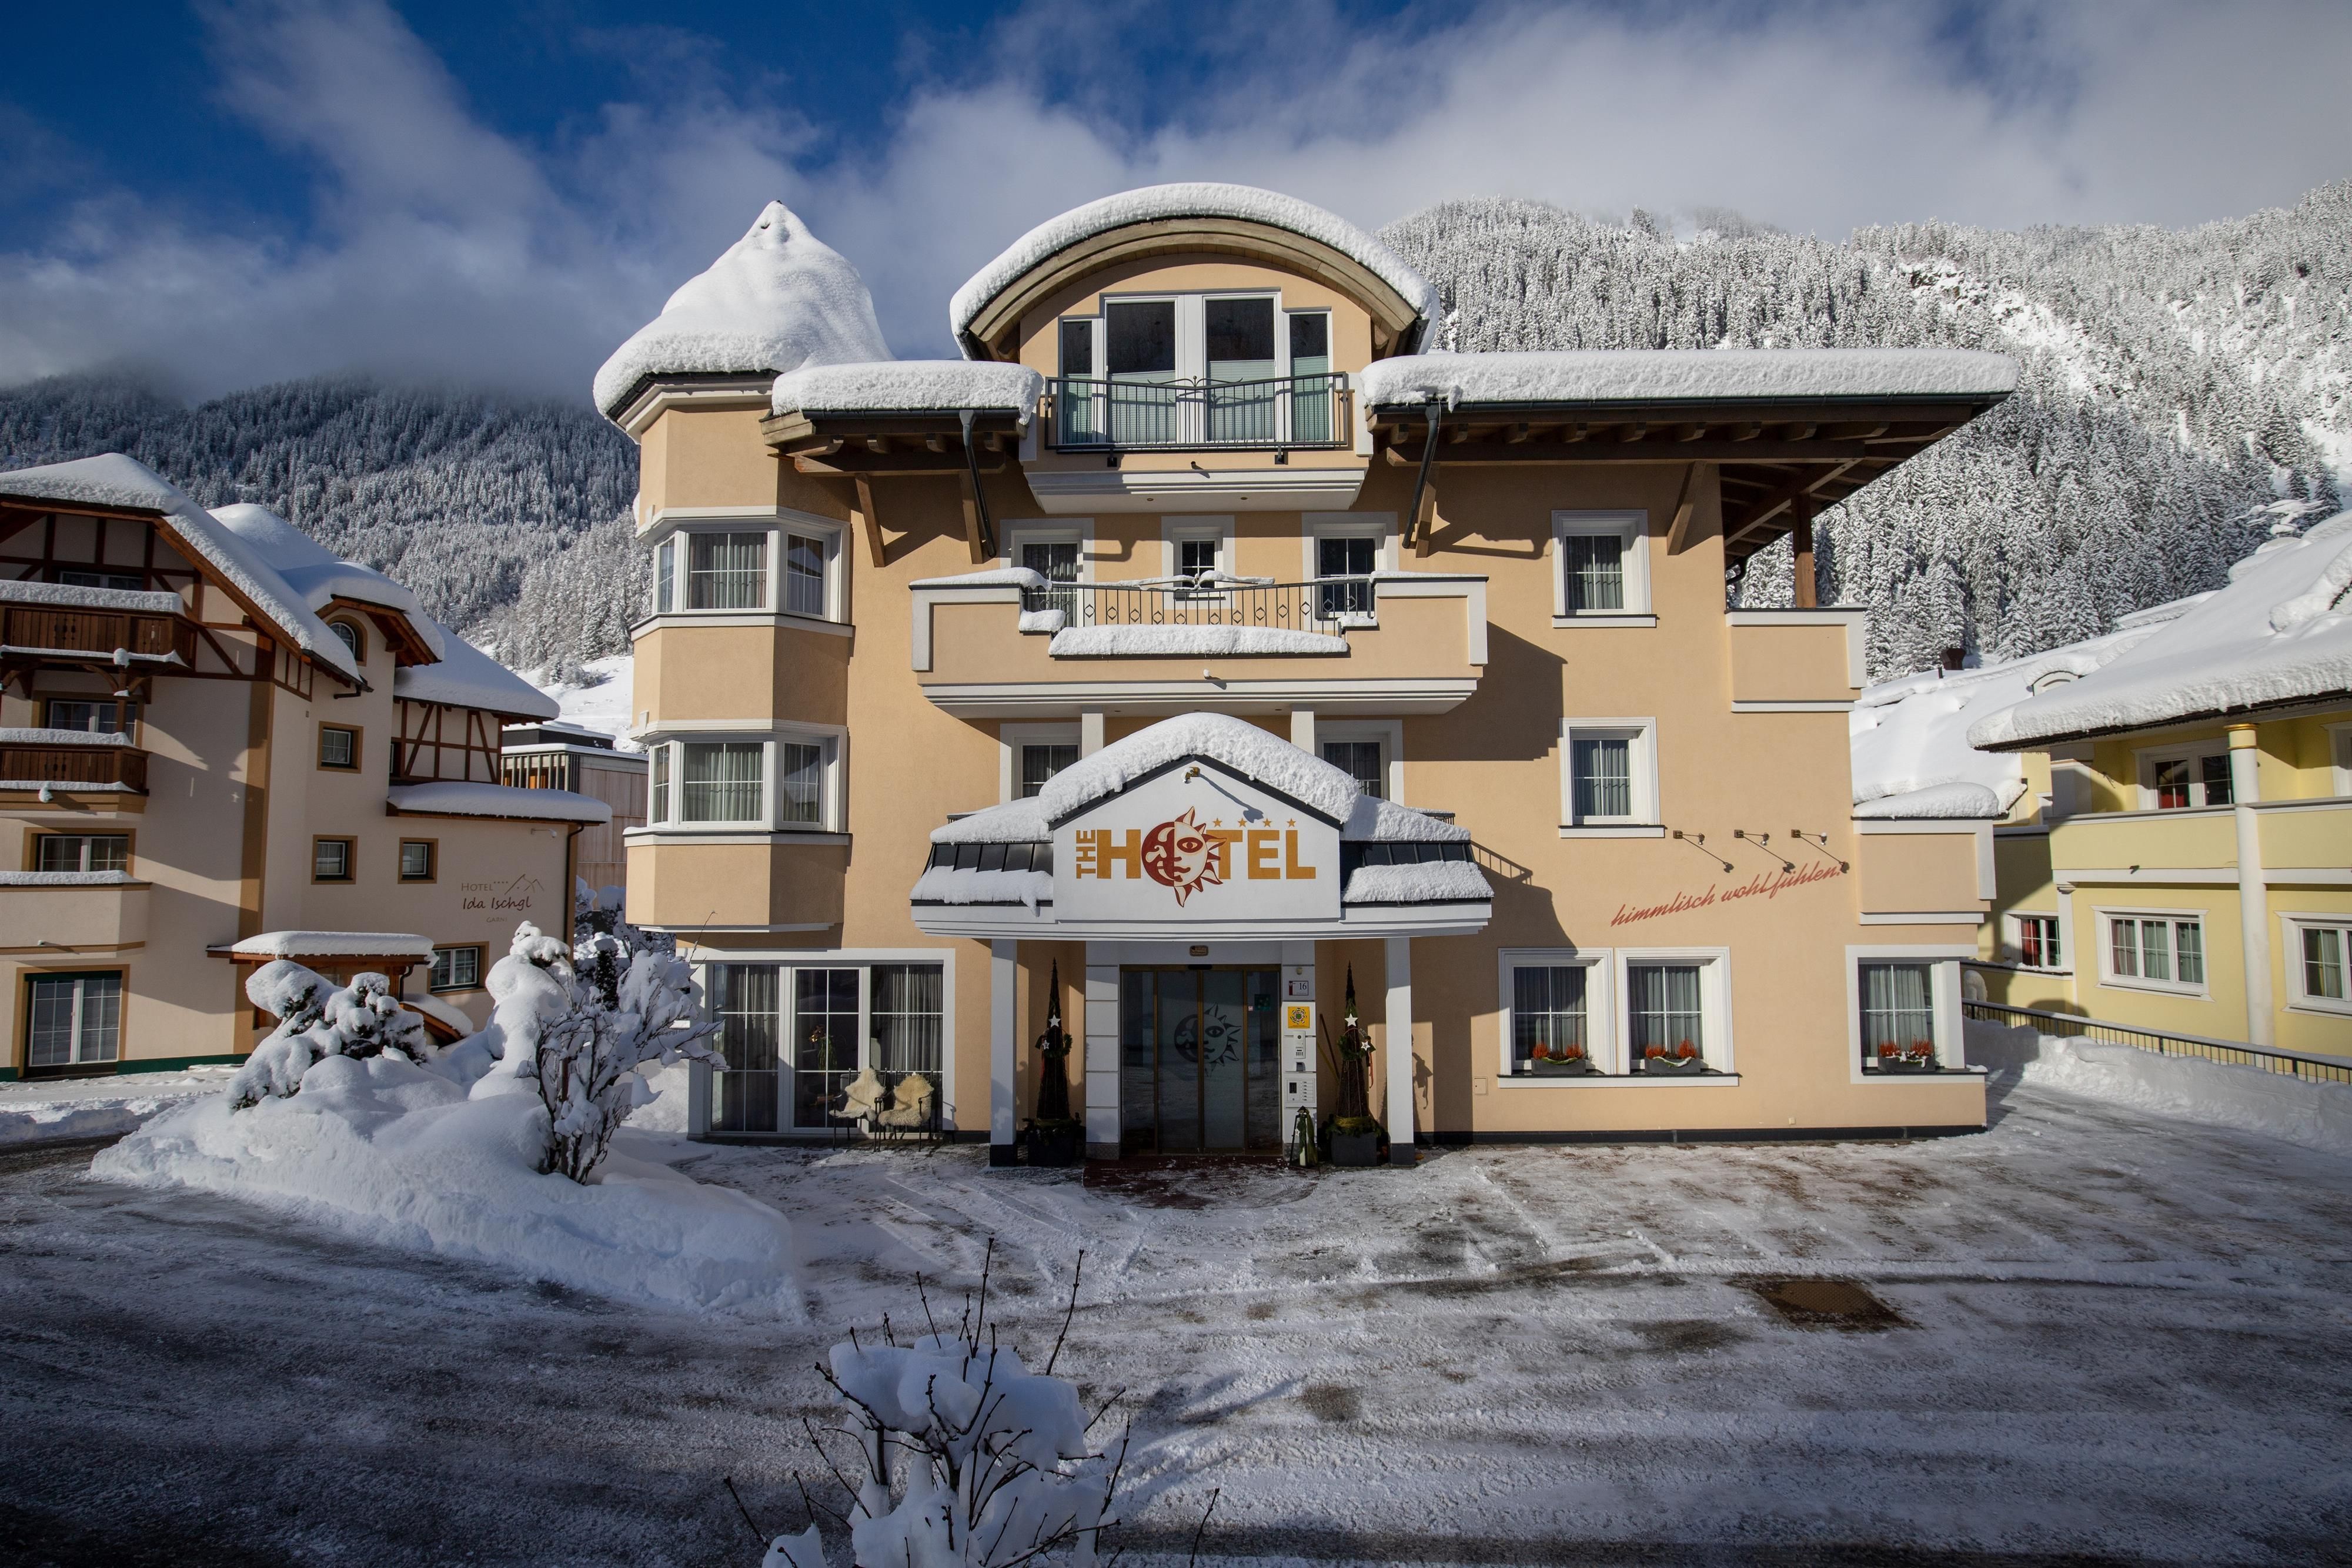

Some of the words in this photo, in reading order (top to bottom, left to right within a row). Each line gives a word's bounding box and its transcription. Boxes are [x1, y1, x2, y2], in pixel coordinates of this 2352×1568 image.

[1076, 829, 1096, 879] THE
[1097, 821, 1317, 887] HOTEL
[461, 883, 493, 891] HOTEL
[463, 897, 486, 910] Ida
[491, 896, 532, 911] Ischgl
[1611, 884, 1716, 927] himmlisch
